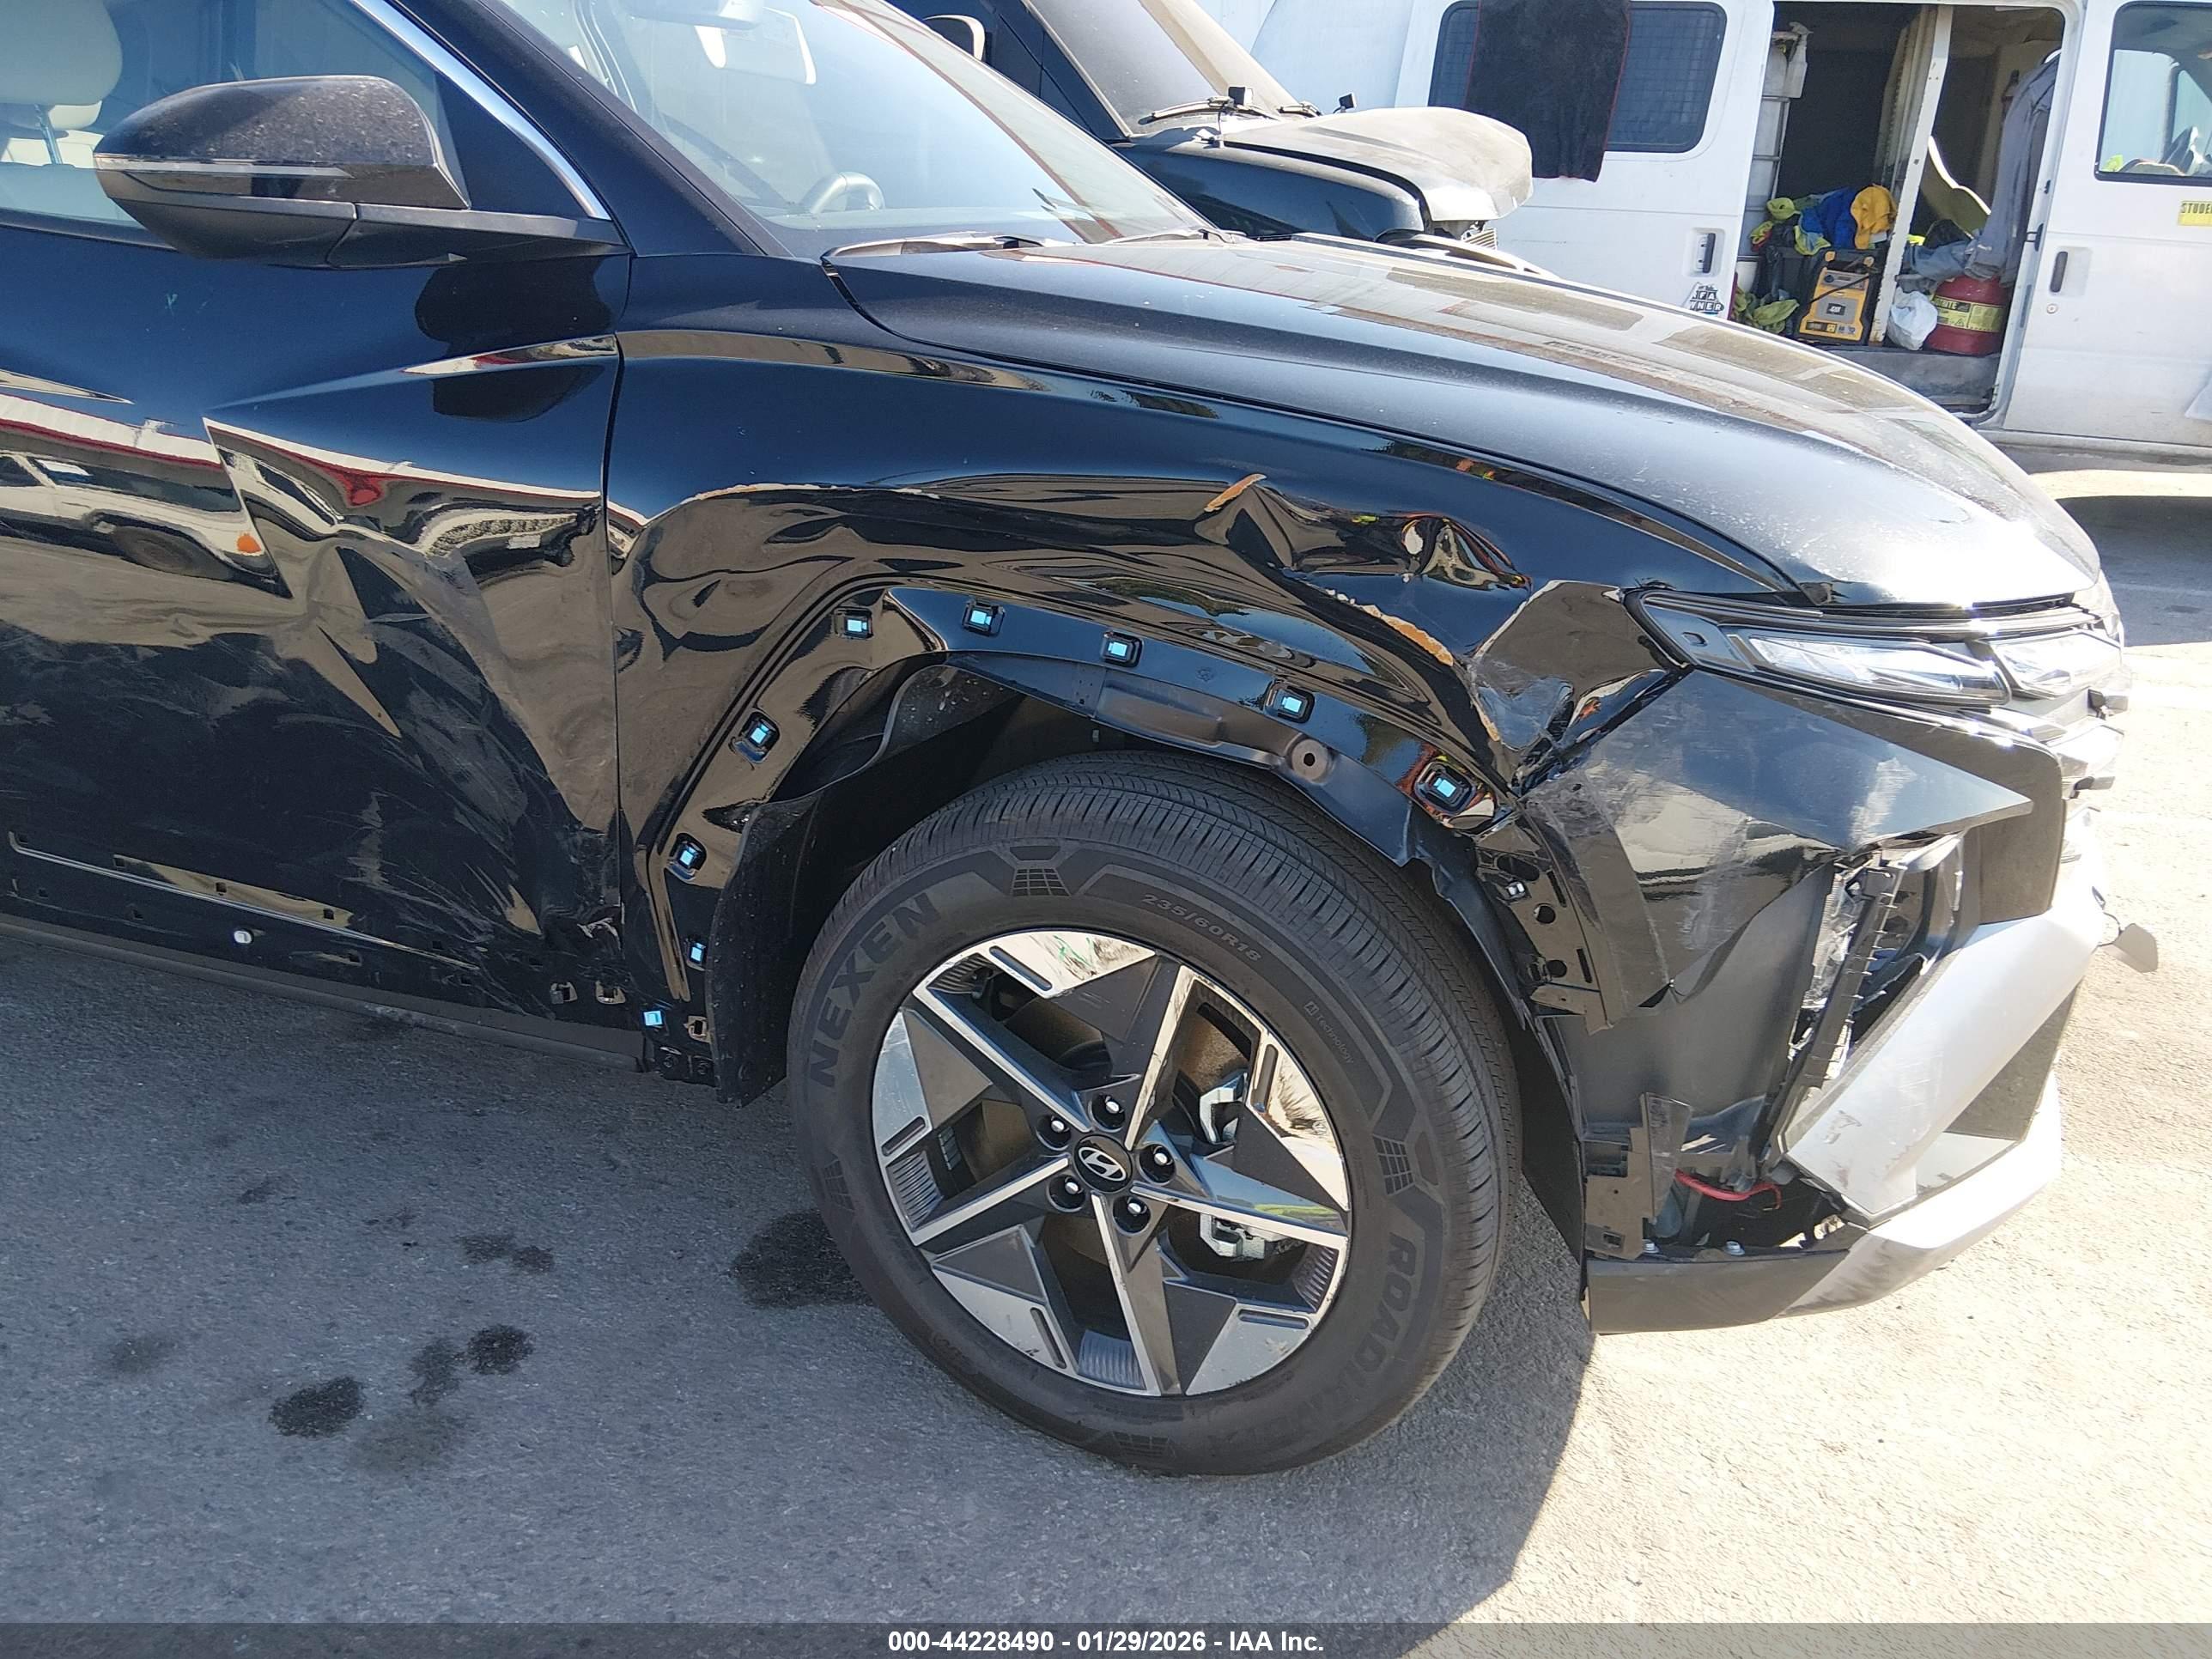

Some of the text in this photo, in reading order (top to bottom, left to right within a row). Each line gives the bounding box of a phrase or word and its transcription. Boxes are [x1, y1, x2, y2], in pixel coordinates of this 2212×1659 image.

[2180, 203, 2212, 214] STUDE
[1142, 894, 1262, 962] 235/60R18
[811, 892, 942, 1087] NEXEN
[1317, 1014, 1354, 1063] Technology
